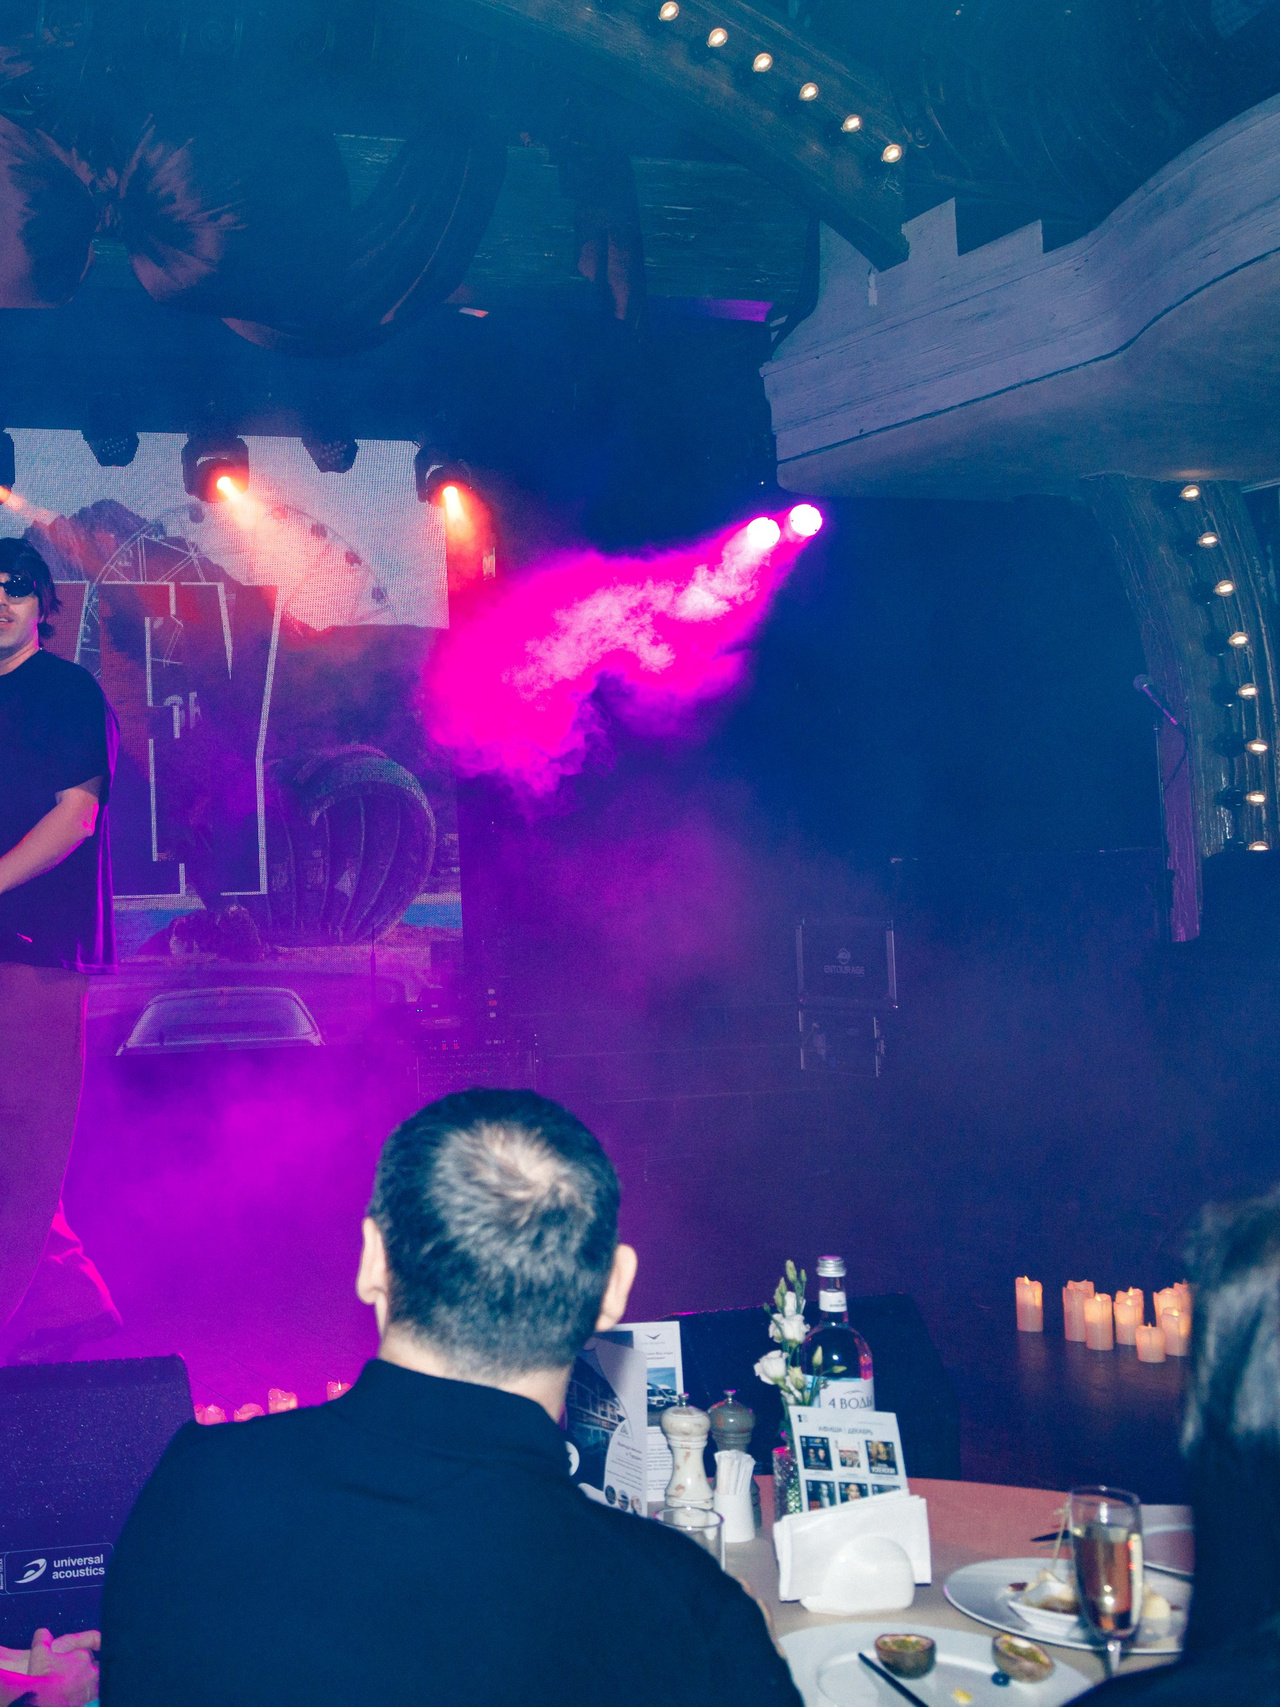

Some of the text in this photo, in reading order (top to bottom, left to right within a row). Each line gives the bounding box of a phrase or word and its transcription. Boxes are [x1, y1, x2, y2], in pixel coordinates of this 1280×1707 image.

[824, 965, 865, 974] ENTOURAGE
[828, 1397, 836, 1409] 4
[53, 1554, 104, 1567] universal
[52, 1566, 105, 1579] acoustics
